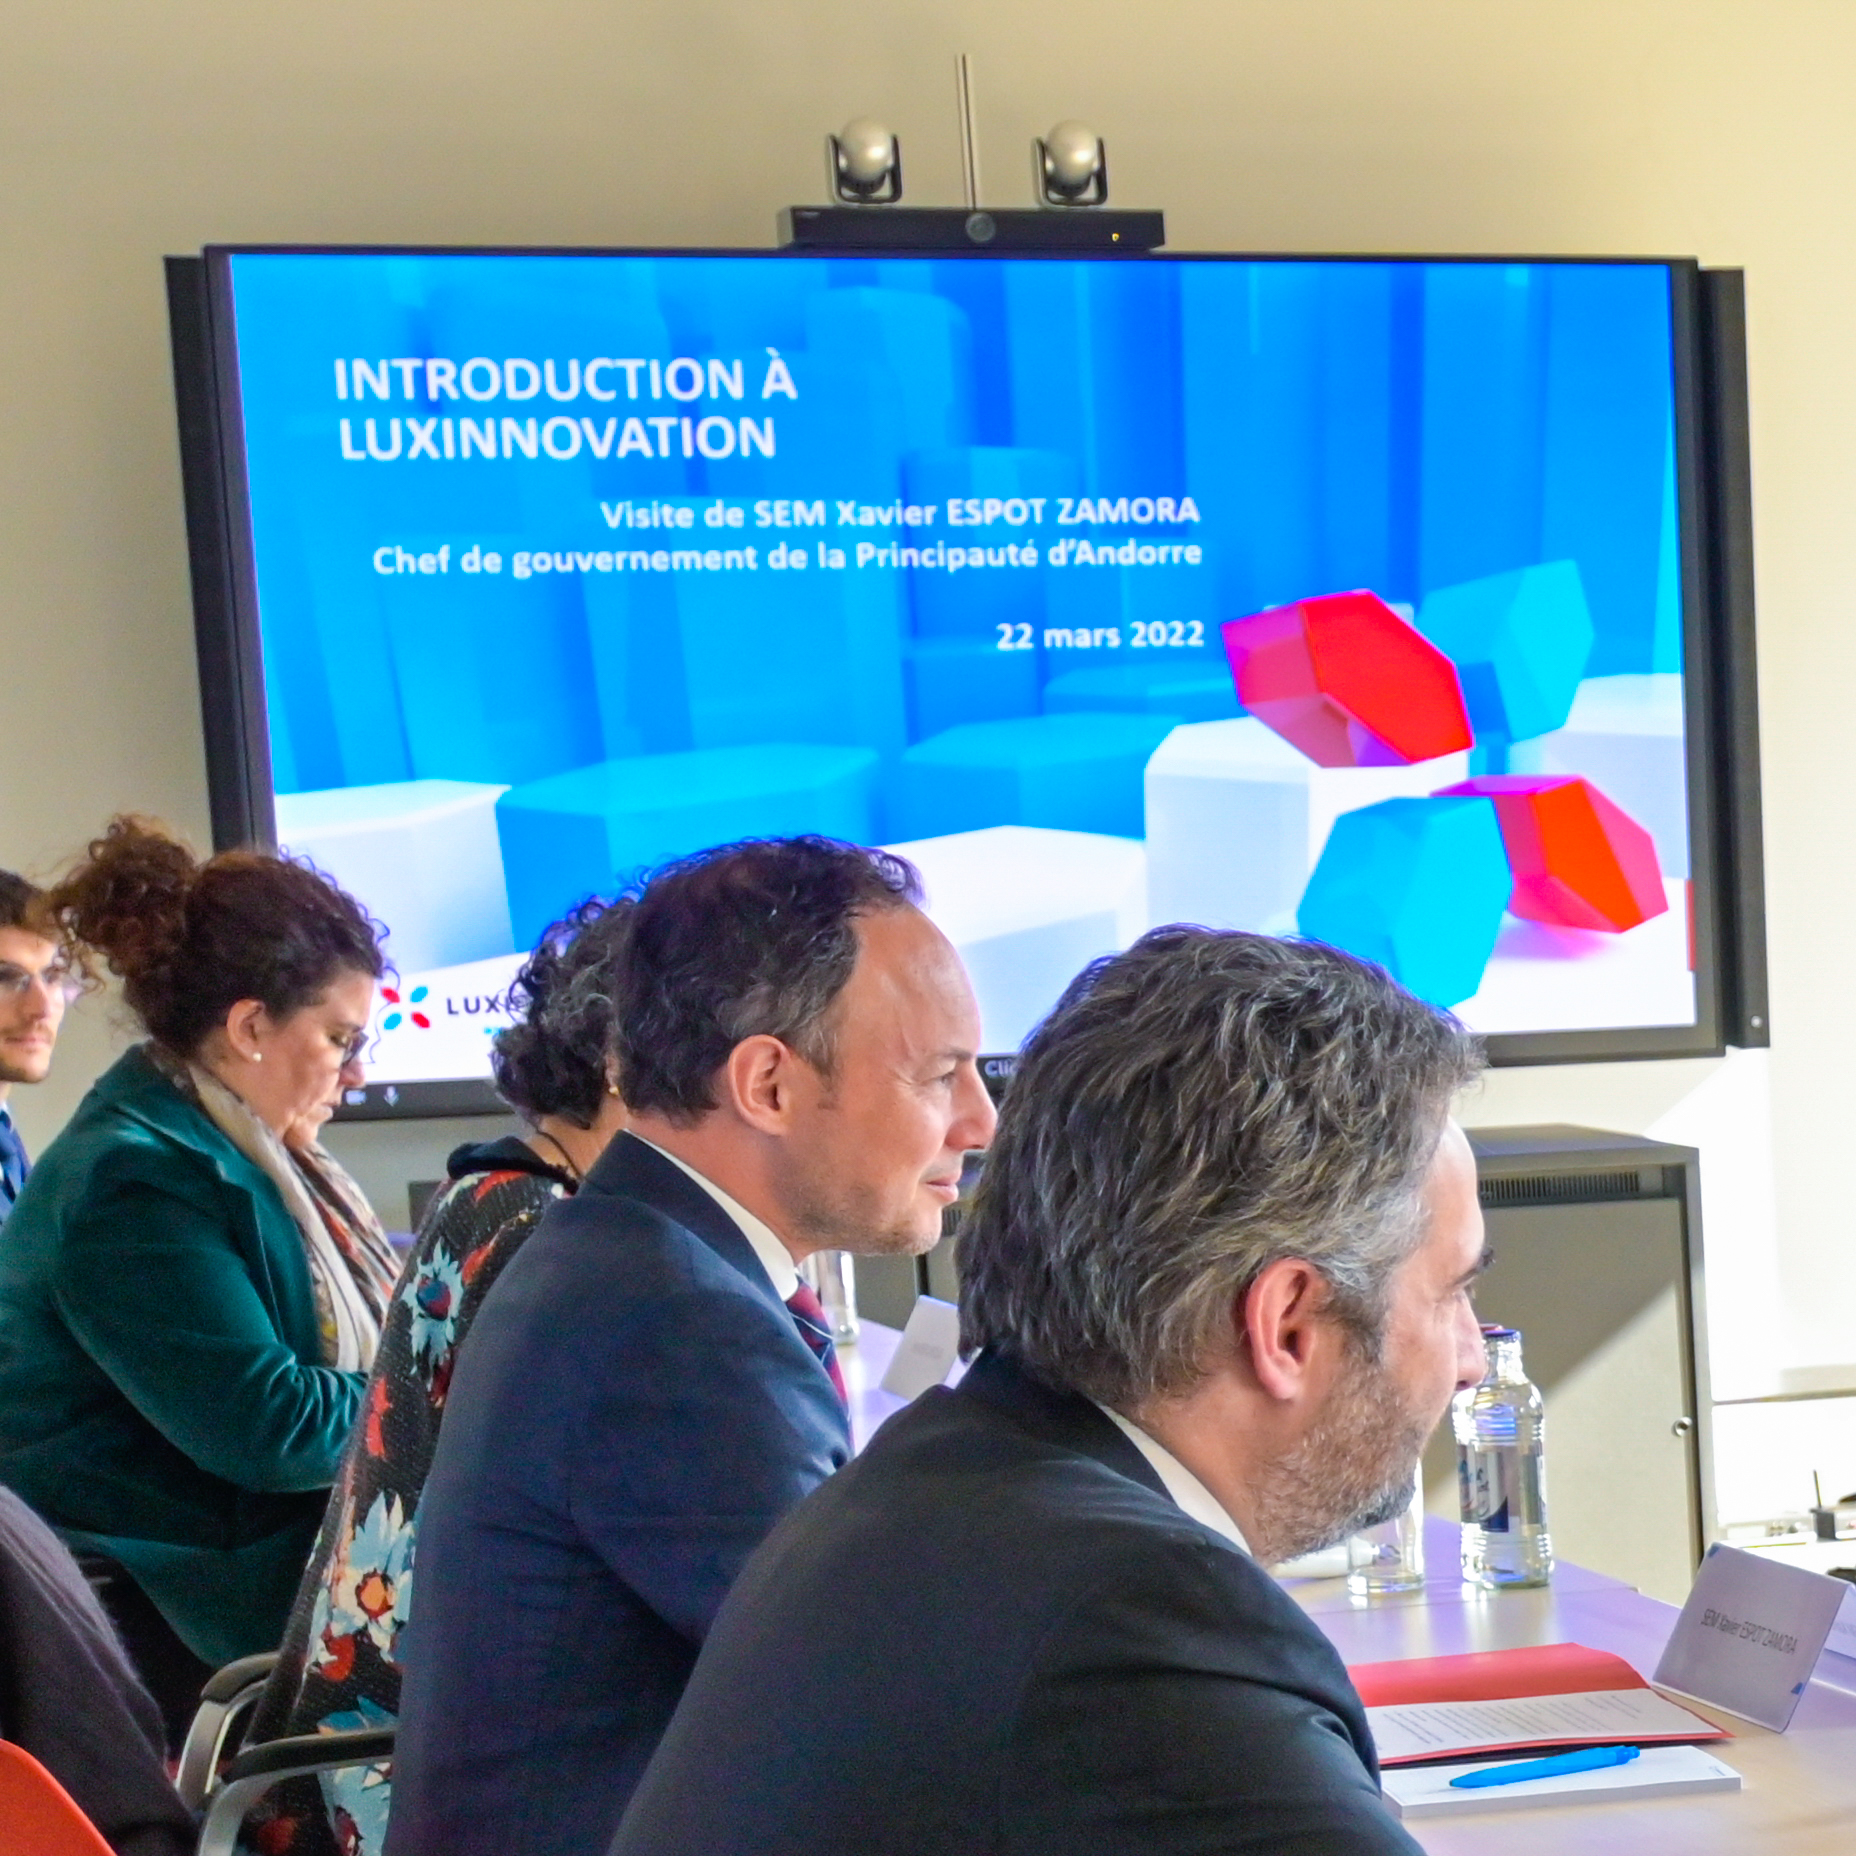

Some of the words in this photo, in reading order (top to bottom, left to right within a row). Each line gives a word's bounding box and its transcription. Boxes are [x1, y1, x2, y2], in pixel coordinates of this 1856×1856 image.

[334, 356, 745, 402] INTRODUCTION
[761, 347, 798, 400] À
[339, 415, 776, 461] LUXINNOVATION
[601, 499, 694, 528] Visite
[704, 499, 745, 528] de
[754, 499, 825, 528] SEM
[837, 498, 938, 527] Xavier
[947, 497, 1046, 527] ESPOT
[1057, 496, 1201, 525] ZAMORA
[373, 543, 450, 575] Chef
[460, 543, 502, 574] de
[512, 544, 758, 580] gouvernement
[768, 541, 808, 570] de
[817, 541, 846, 569] la
[855, 538, 1038, 573] Principauté
[1048, 537, 1203, 567] d'Andorre
[996, 622, 1034, 652] 22
[1043, 626, 1121, 649] mars
[1129, 619, 1205, 649] 2022
